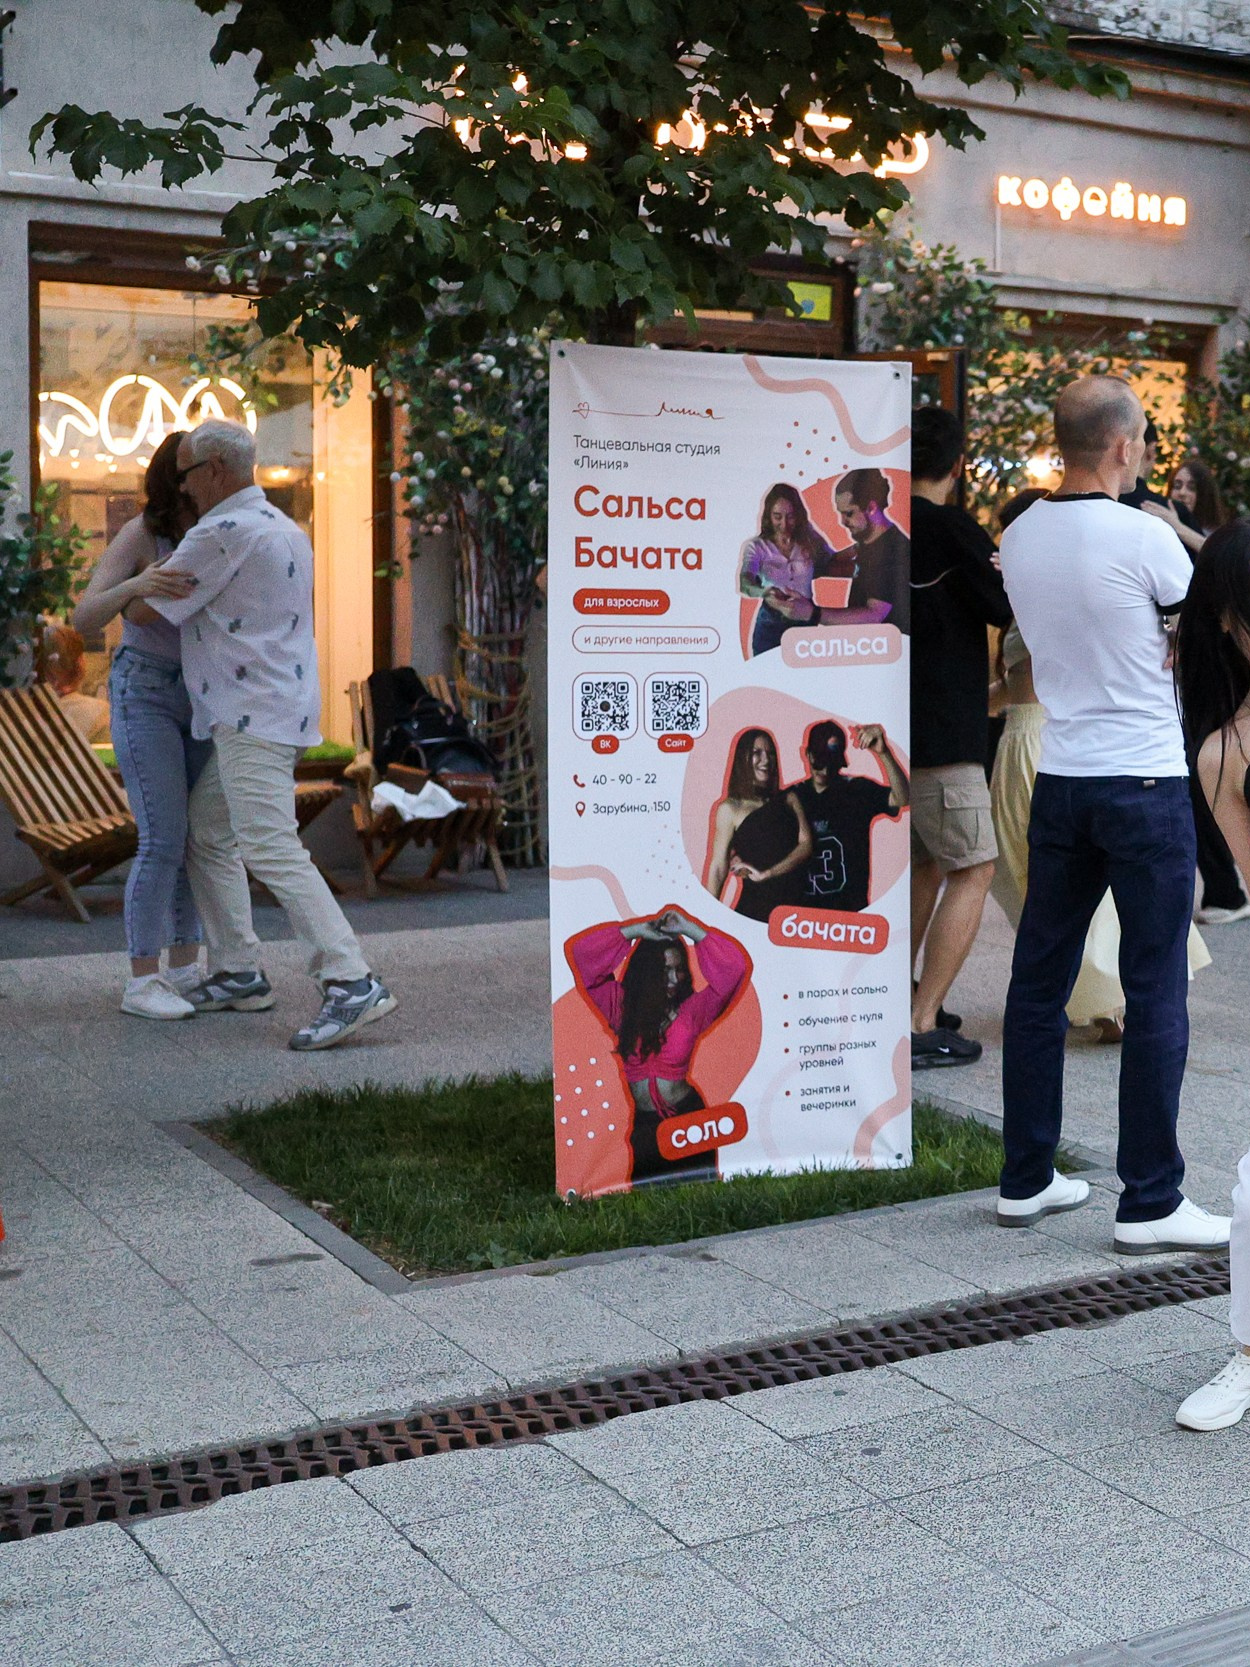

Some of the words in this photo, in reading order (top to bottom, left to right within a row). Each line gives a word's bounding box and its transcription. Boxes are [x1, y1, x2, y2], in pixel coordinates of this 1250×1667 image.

[573, 434, 672, 453] Танцевальная
[675, 442, 721, 457] студия
[573, 455, 629, 470] «Линия»
[574, 484, 706, 520] Сальса
[575, 536, 702, 570] Бачата
[583, 597, 604, 609] для
[606, 598, 660, 609] взрослых
[584, 635, 591, 643] и
[593, 635, 633, 646] другие
[635, 635, 709, 646] направления
[795, 636, 889, 659] сальса
[600, 737, 612, 749] ВК
[664, 738, 687, 748] Сайт
[592, 774, 608, 785] 40
[618, 773, 633, 785] 90
[644, 773, 657, 784] 22
[592, 802, 650, 815] Зарубина,
[653, 800, 671, 812] 150
[781, 913, 876, 945] бачата
[798, 990, 804, 999] в
[806, 988, 840, 999] парах
[842, 988, 849, 996] и
[851, 985, 888, 996] сольно
[798, 1014, 849, 1028] обучение
[851, 1013, 857, 1022] с
[859, 1012, 883, 1024] нуля
[799, 1043, 837, 1055] группы
[840, 1040, 877, 1052] разных
[799, 1056, 844, 1071] уровней
[800, 1085, 841, 1097] занятия
[843, 1084, 850, 1093] и
[800, 1098, 857, 1112] вечеринки
[671, 1116, 735, 1148] соло
